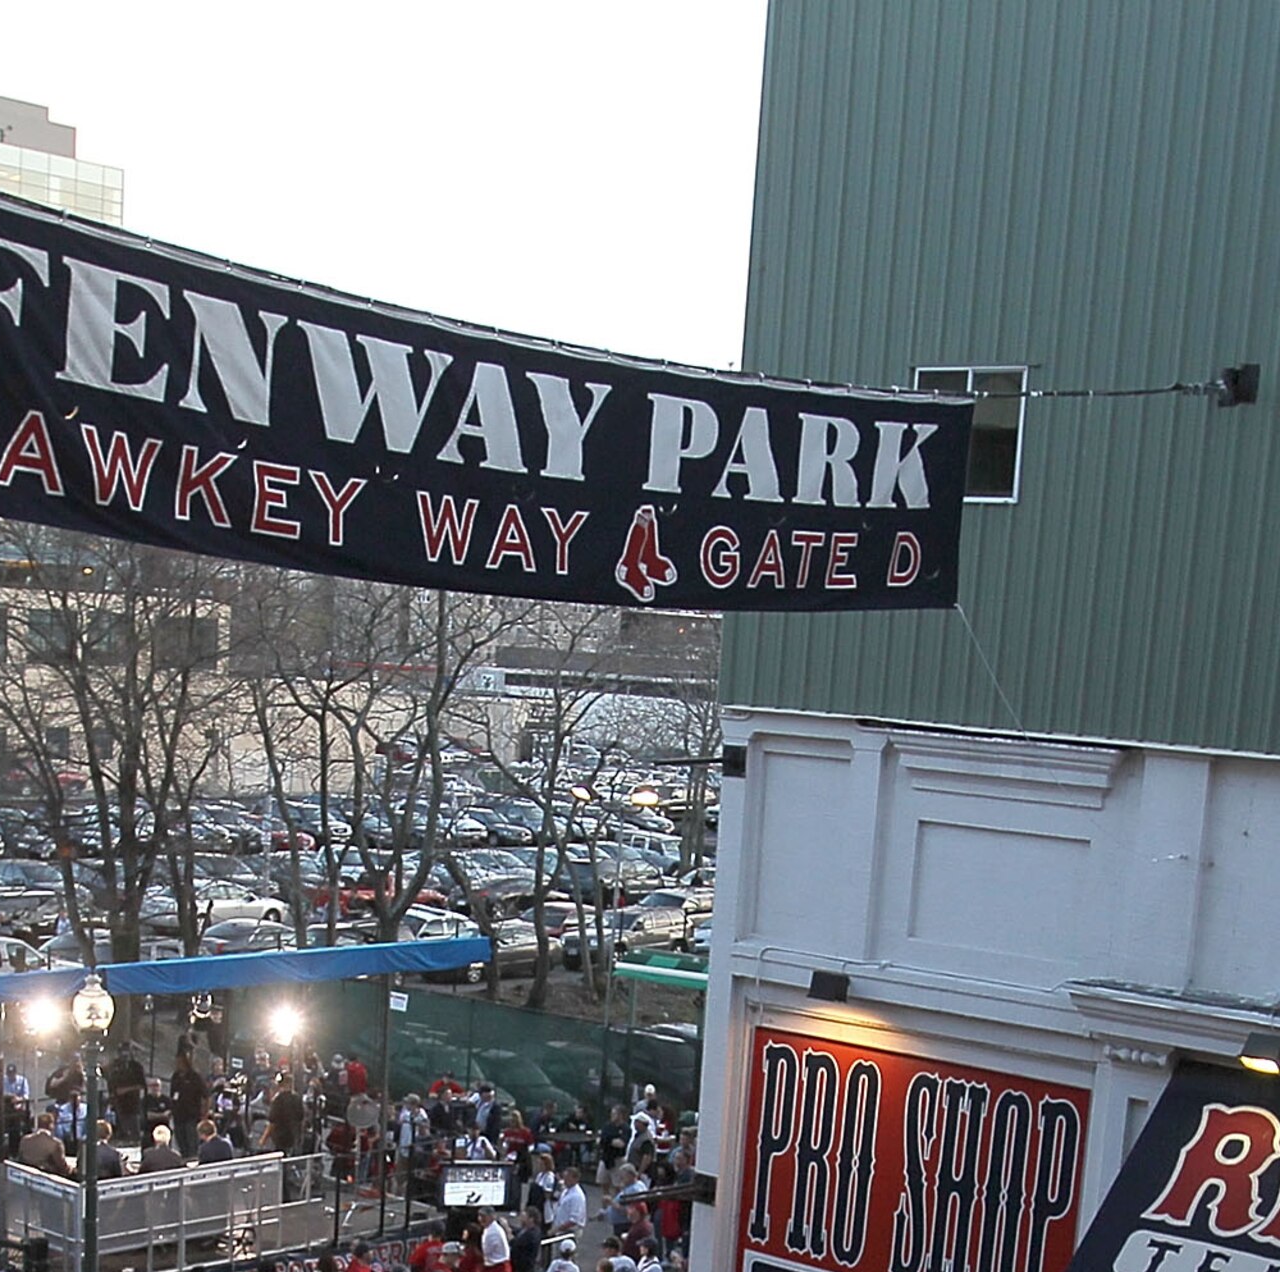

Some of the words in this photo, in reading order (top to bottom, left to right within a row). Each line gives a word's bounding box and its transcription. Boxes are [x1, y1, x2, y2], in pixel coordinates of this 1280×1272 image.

[642, 393, 939, 510] PARK
[416, 489, 591, 575] WAY
[700, 525, 860, 589] GATE
[886, 531, 922, 587] D
[748, 1040, 882, 1268] PRO
